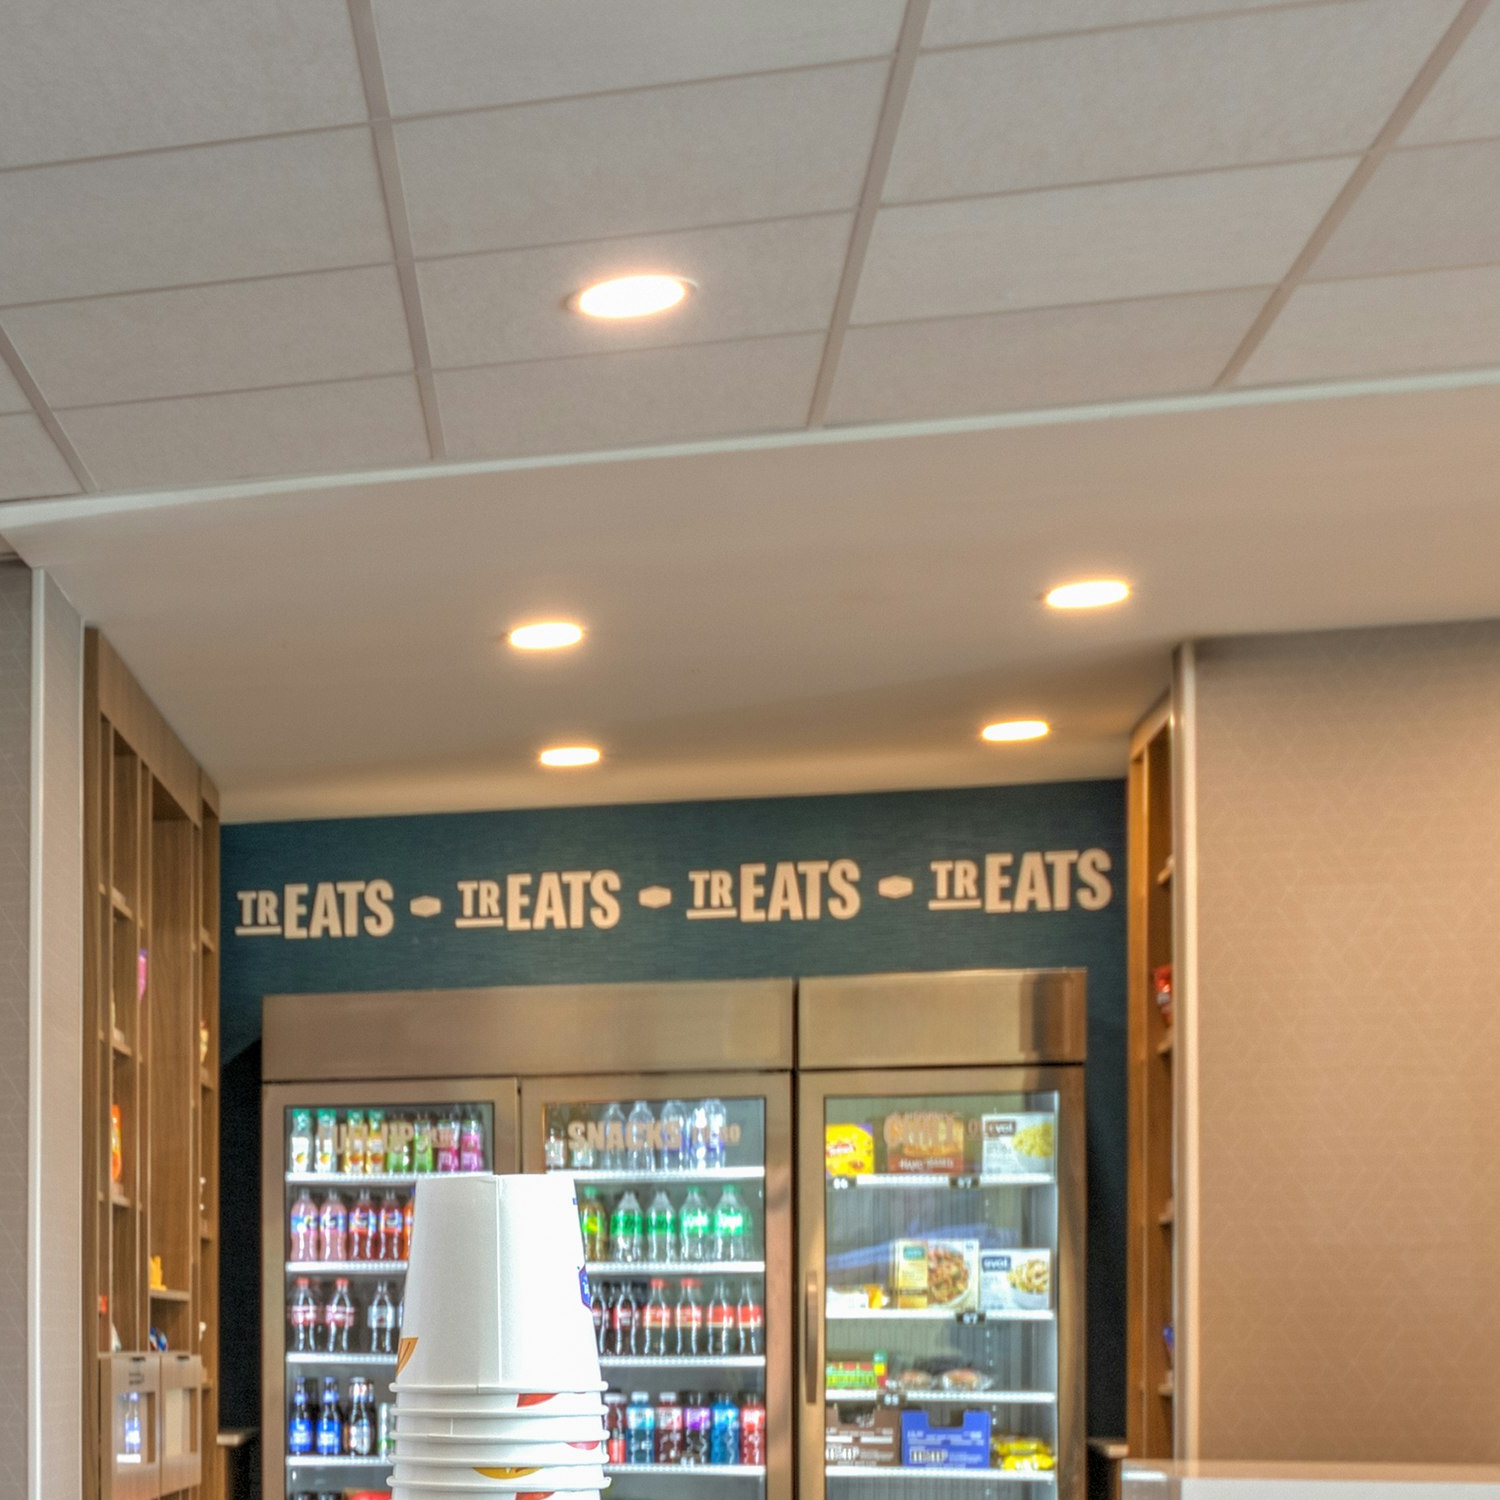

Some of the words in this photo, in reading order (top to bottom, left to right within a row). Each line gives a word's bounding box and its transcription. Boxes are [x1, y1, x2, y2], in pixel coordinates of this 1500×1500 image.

[235, 879, 395, 939] TREATS
[455, 869, 622, 930] TREATS
[686, 857, 862, 924] TREATS
[928, 847, 1114, 914] TREATS
[567, 1120, 684, 1151] SNACKS
